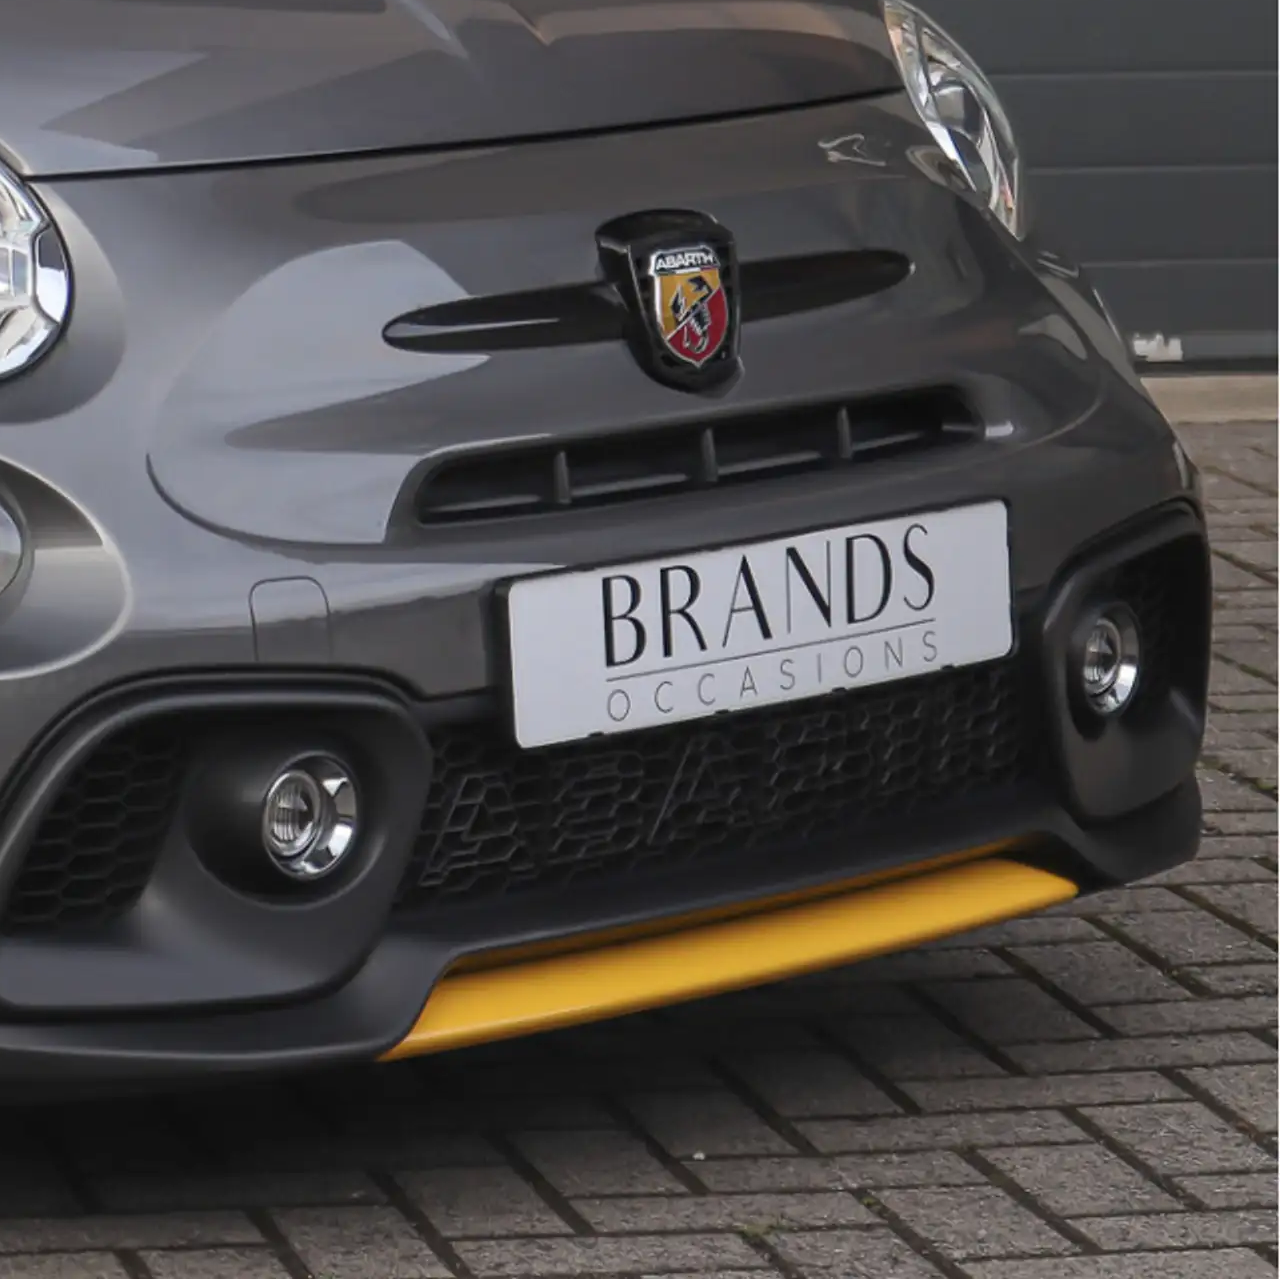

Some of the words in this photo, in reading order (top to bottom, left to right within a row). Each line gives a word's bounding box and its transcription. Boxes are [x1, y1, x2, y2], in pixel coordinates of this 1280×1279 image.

[655, 251, 714, 271] ABARTH
[600, 523, 936, 668] BRANDS
[605, 631, 939, 722] OCCASIONS
